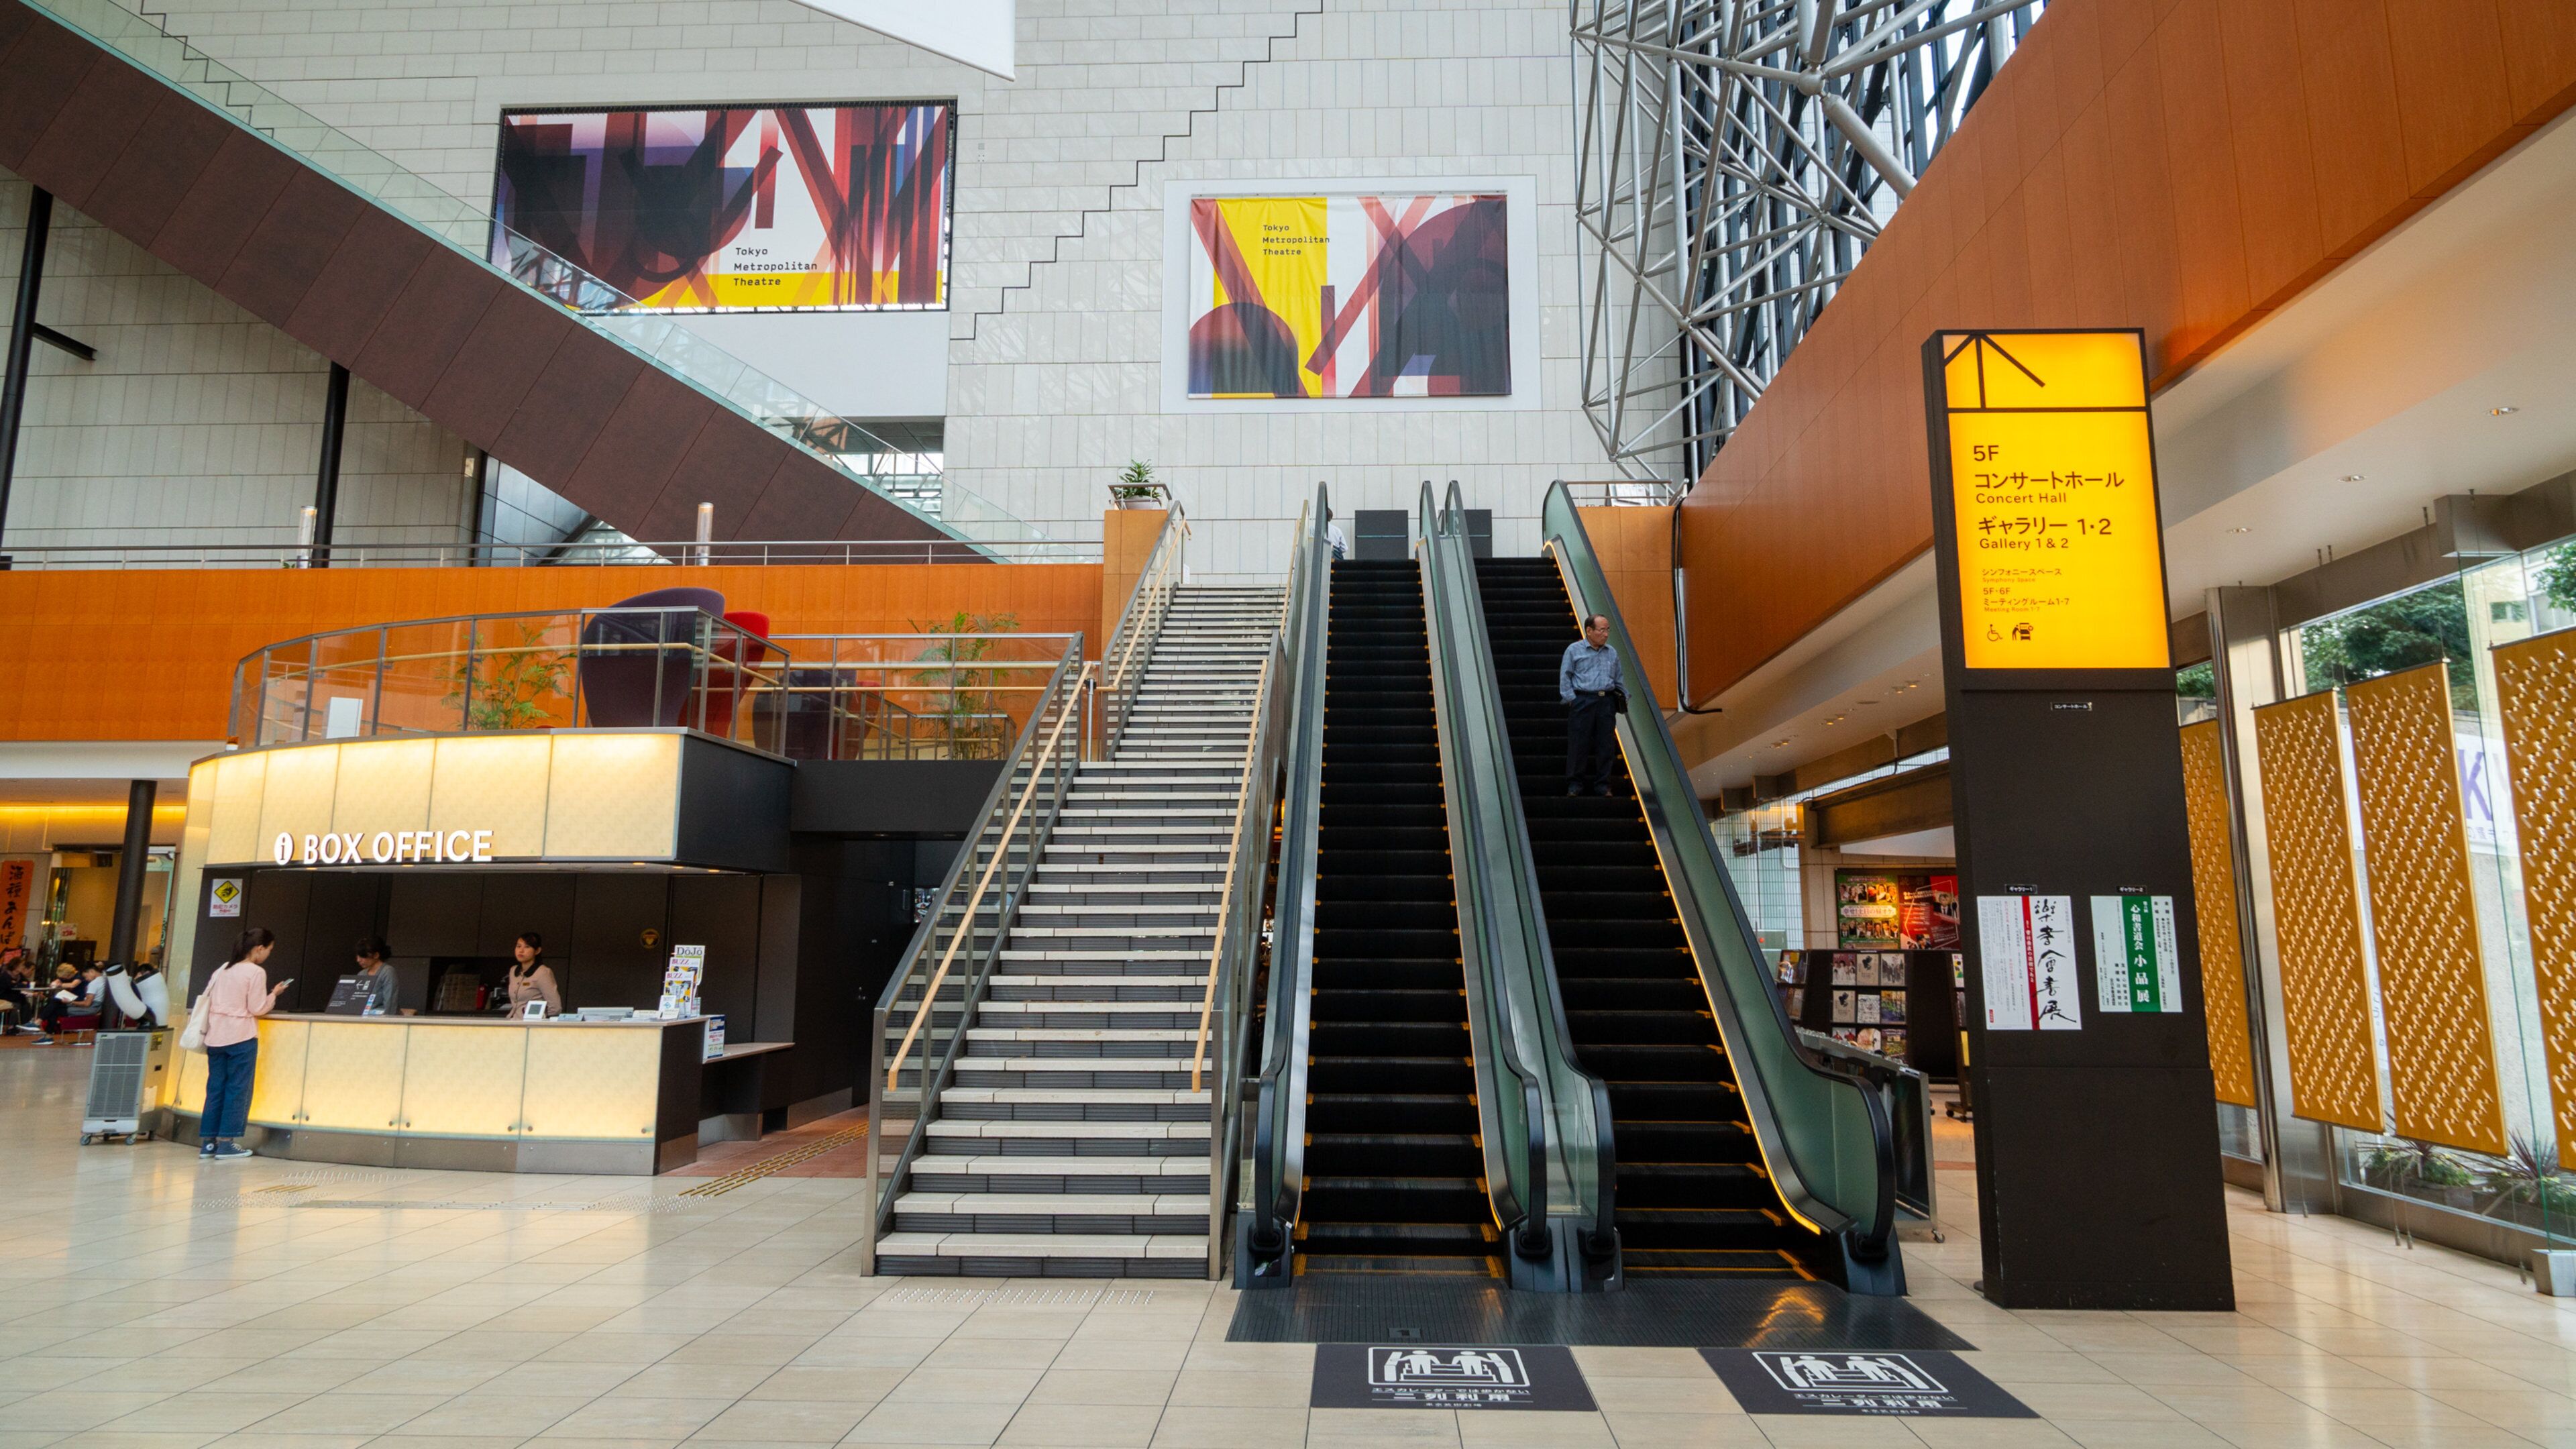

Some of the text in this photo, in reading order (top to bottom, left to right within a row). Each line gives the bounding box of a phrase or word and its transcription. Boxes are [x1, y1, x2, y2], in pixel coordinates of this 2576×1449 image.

[736, 248, 768, 257] Tokyo
[734, 262, 818, 272] Metropolitan
[733, 278, 781, 286] Theatre
[1974, 445, 1999, 462] 5F
[1975, 471, 2125, 490] コンサートホール
[1976, 492, 2066, 503] Concert Hall
[1978, 515, 2068, 535] ギャラリー
[1980, 537, 2069, 550] Gallery 1 & 2
[1982, 568, 2062, 576] シンフォニースペース
[303, 833, 365, 864] BOX
[372, 830, 494, 863] OFFICE
[2134, 954, 2150, 1003] 小品展
